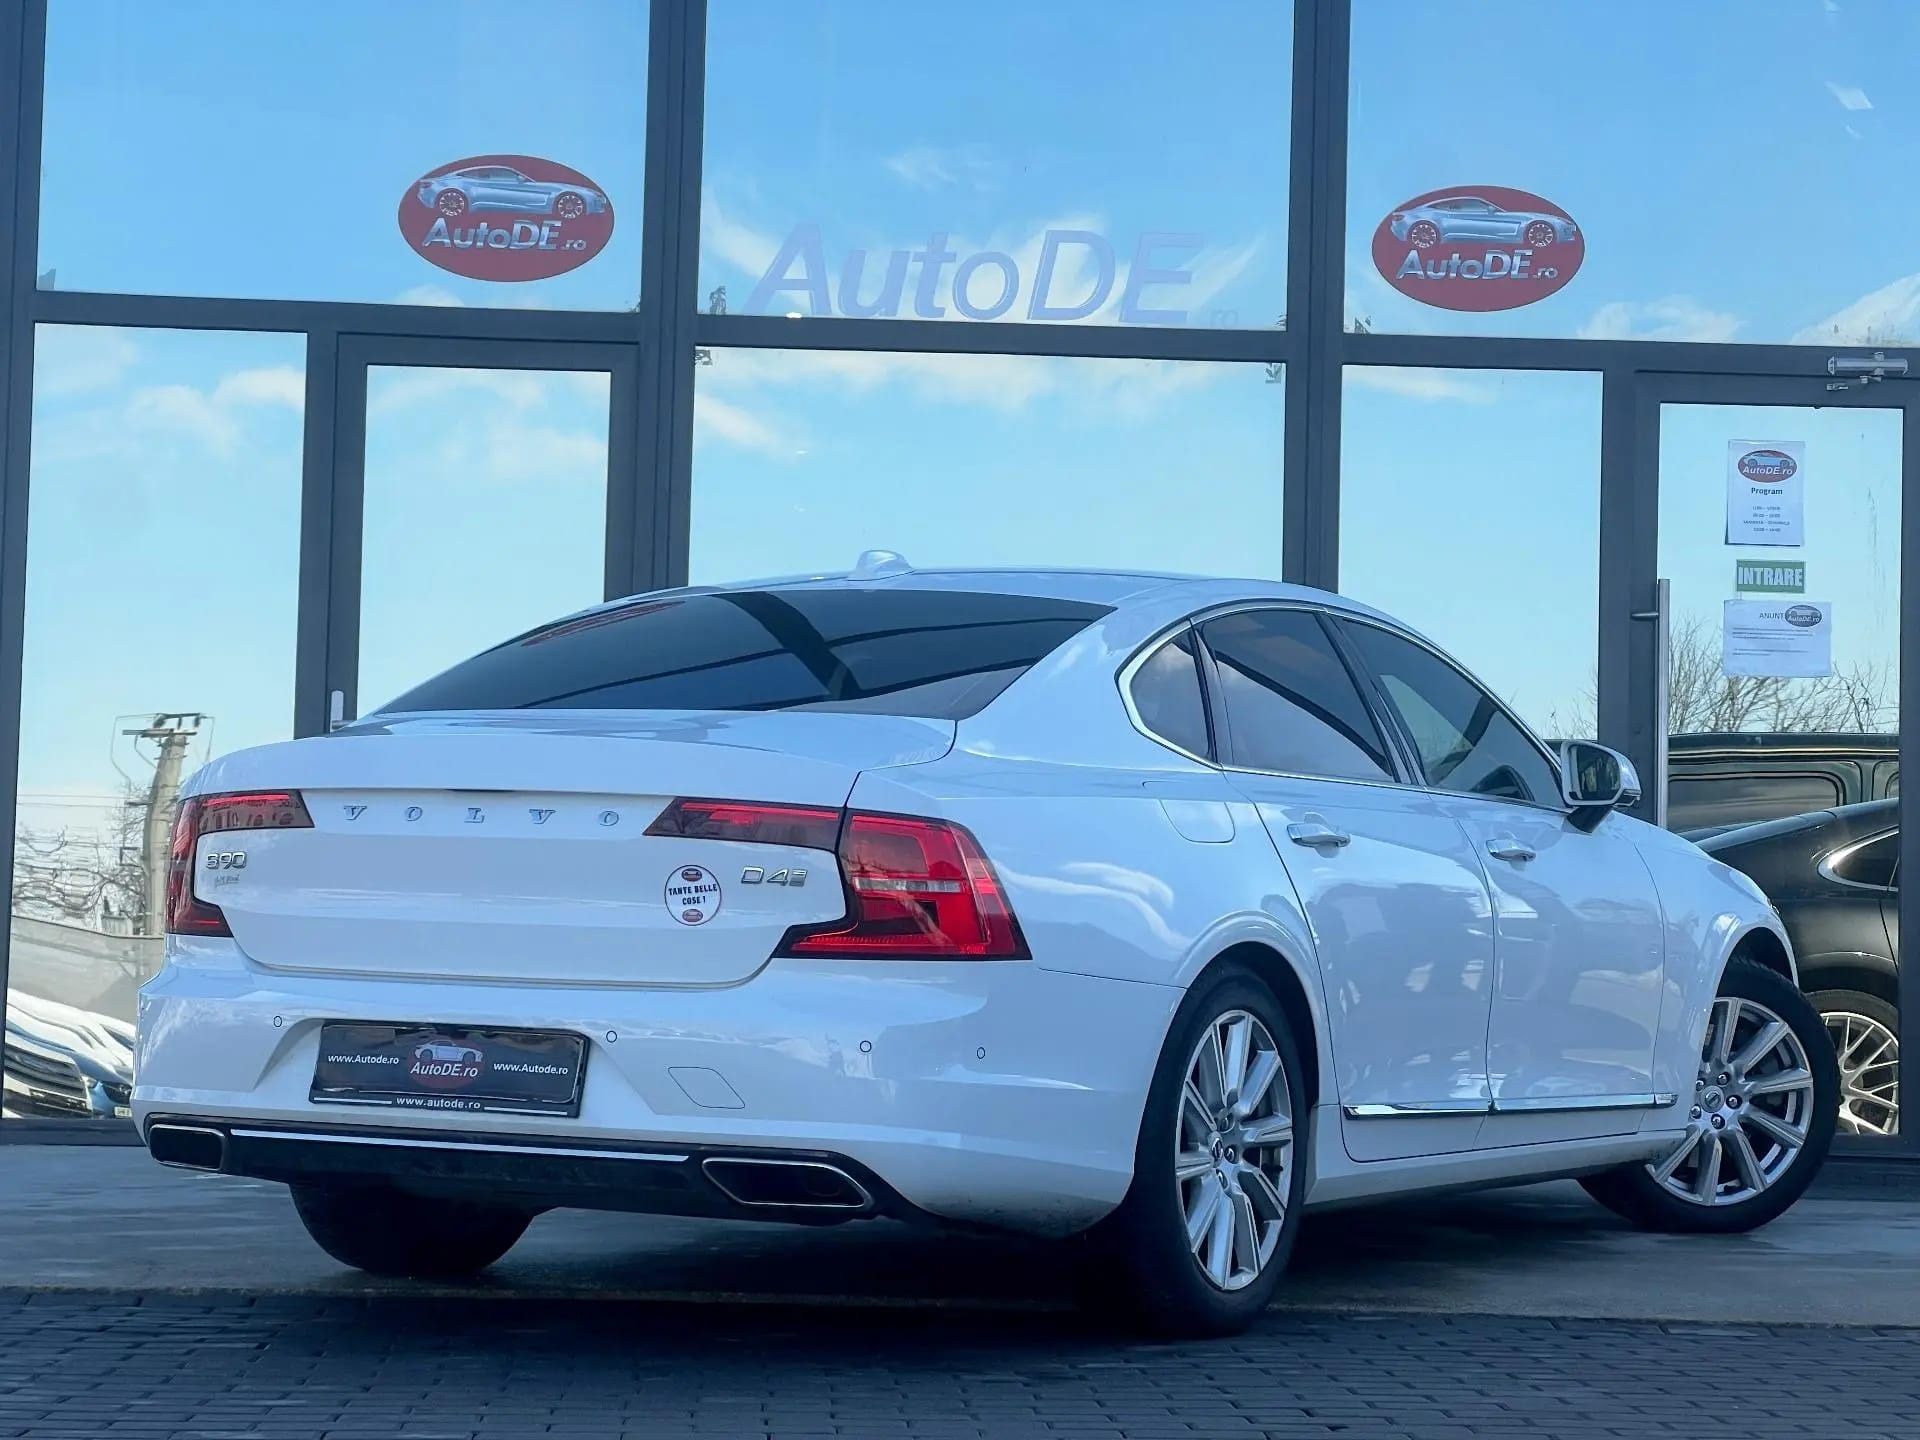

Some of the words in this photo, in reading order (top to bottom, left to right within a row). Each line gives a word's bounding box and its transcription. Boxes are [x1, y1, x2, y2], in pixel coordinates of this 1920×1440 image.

[1751, 487, 1783, 496] Program
[1738, 567, 1803, 587] INTRARE
[343, 805, 620, 827] VOLVO
[206, 851, 247, 870] S90
[668, 886, 692, 896] TANTE
[694, 883, 718, 893] BELLE
[328, 1053, 399, 1065] www.Autode.ro
[410, 1062, 478, 1078] AutoDE.ro
[493, 1062, 568, 1076] www.Autode.ro
[396, 1096, 481, 1110] www.autode.ro
